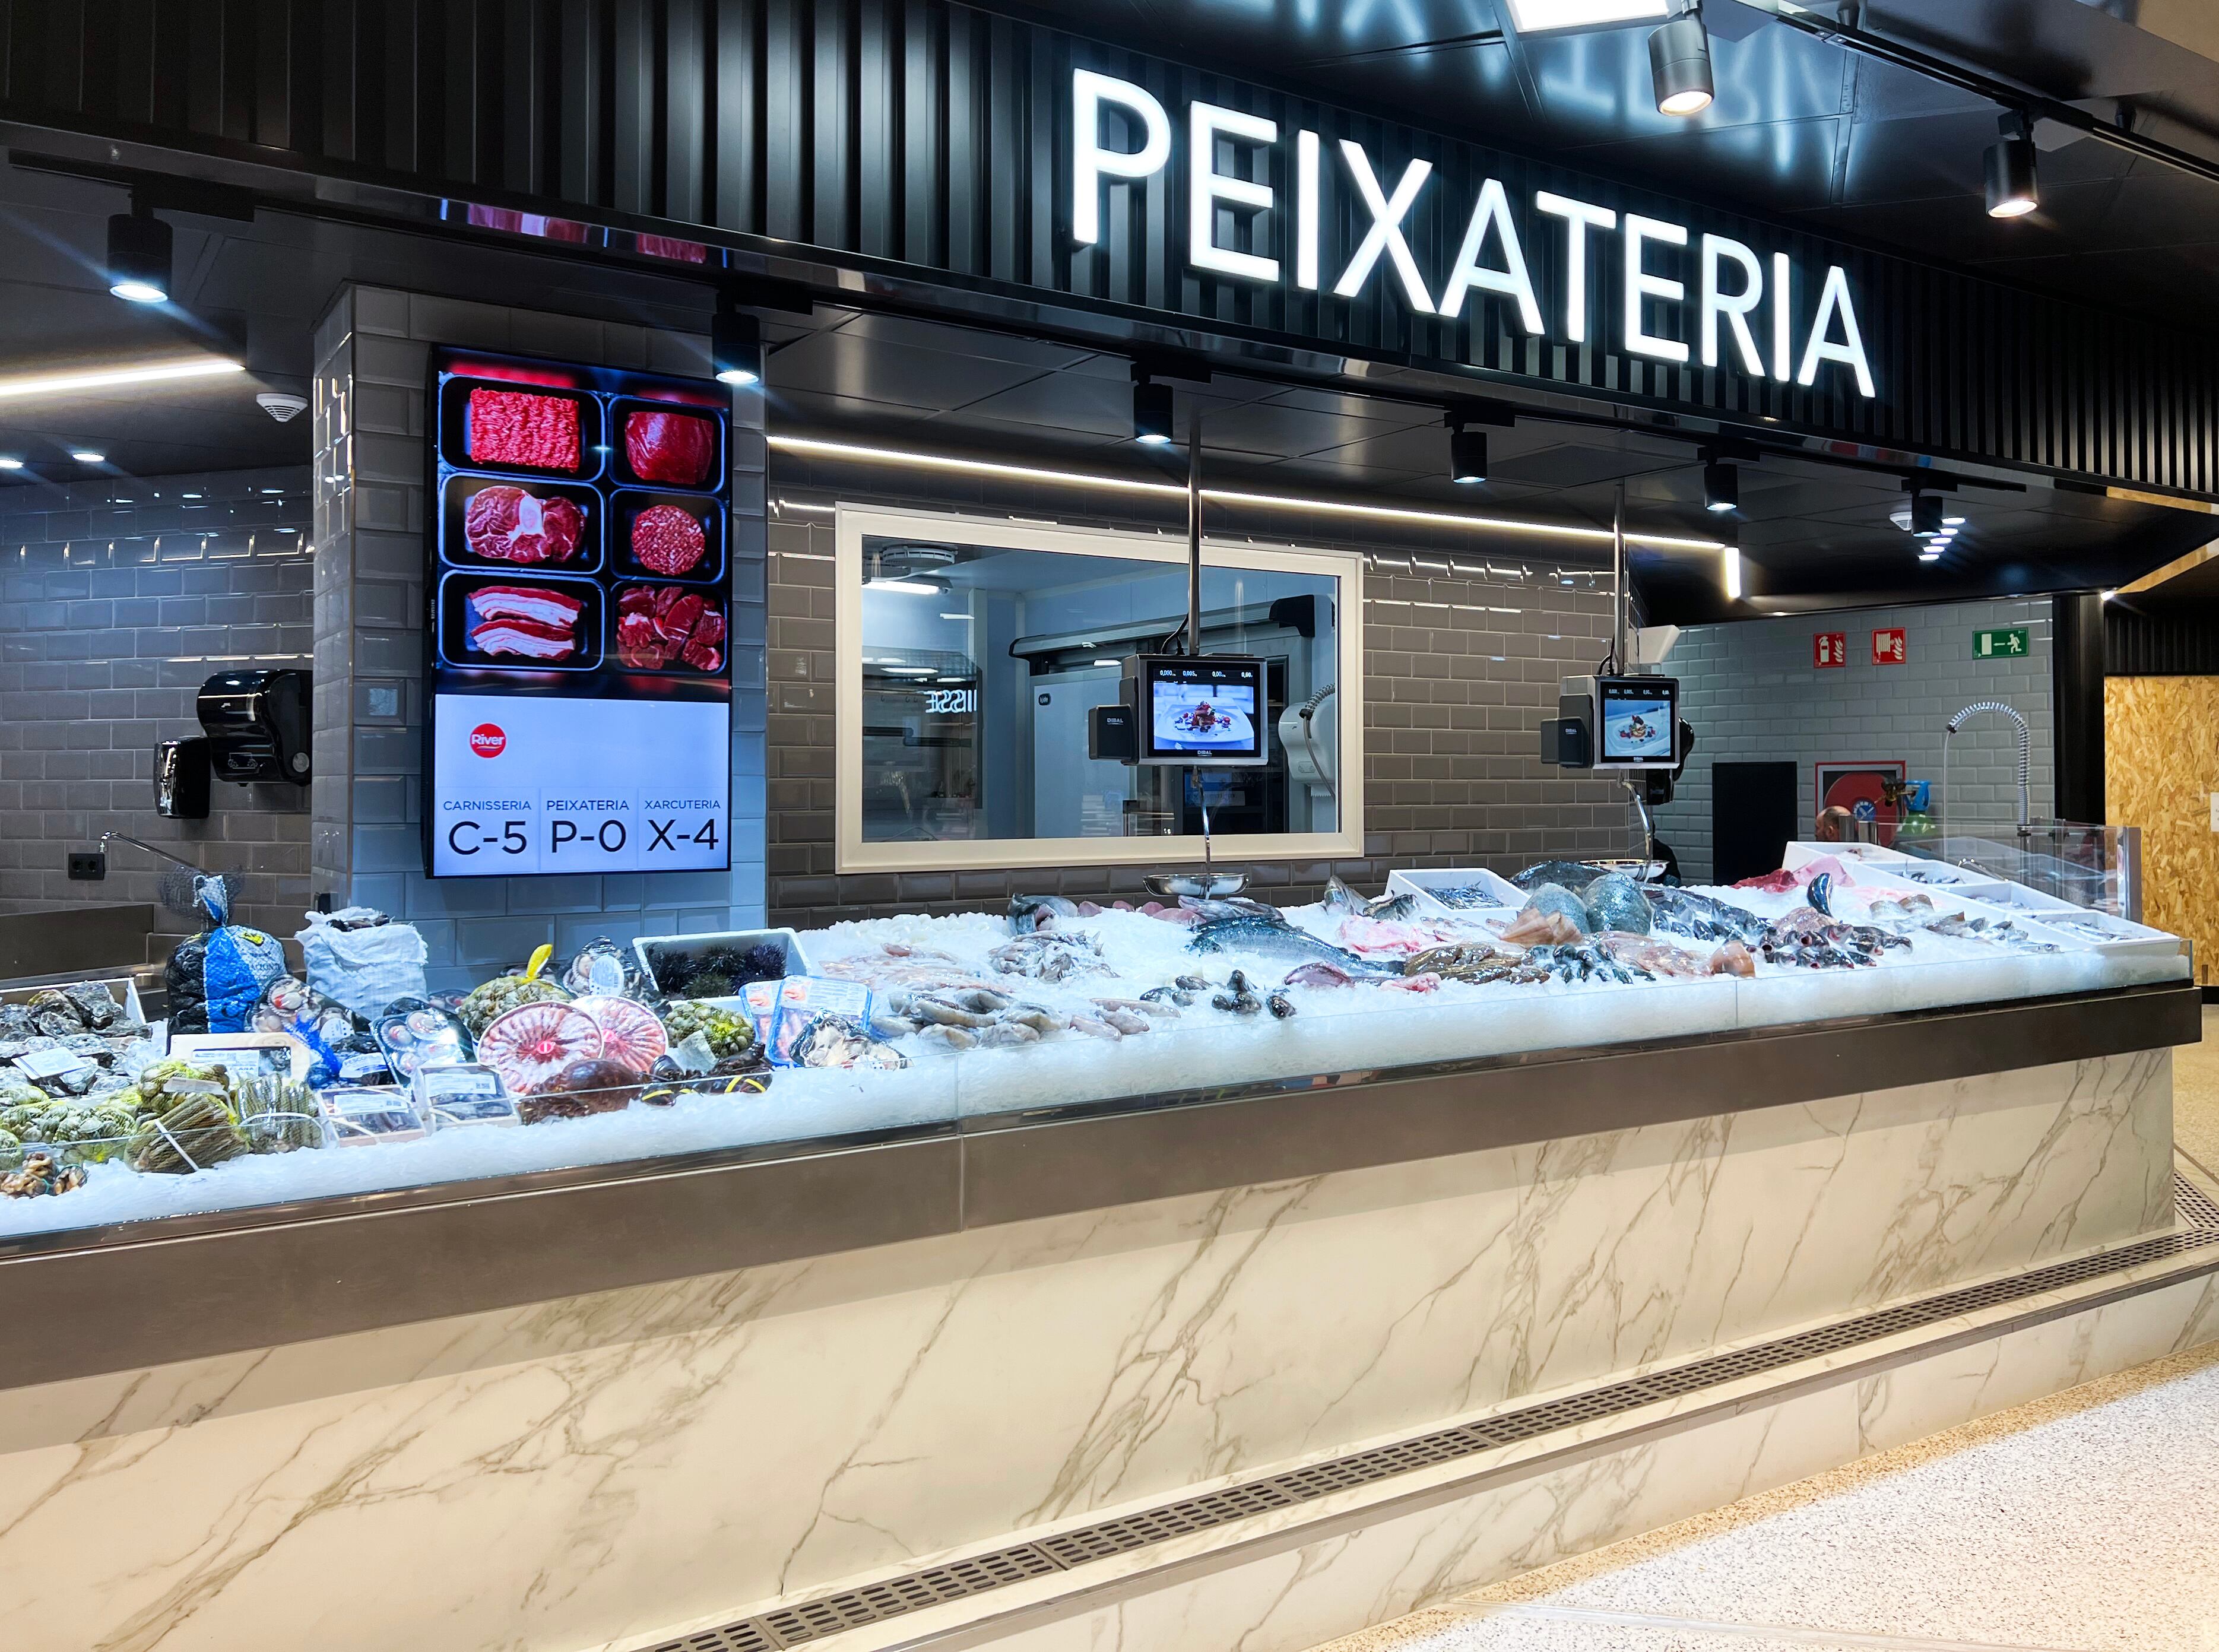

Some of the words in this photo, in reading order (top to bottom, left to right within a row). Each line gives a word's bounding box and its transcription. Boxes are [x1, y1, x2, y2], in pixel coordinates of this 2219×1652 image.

[1073, 67, 1876, 397] PEIXATERIA
[471, 733, 505, 746] River
[443, 800, 532, 811] CARNISSERIA
[546, 800, 630, 811] PEIXATERIA
[644, 800, 721, 810] XARCUTERIA
[449, 820, 527, 855] C-5
[551, 819, 626, 854] P-0
[646, 818, 719, 851] X-4
